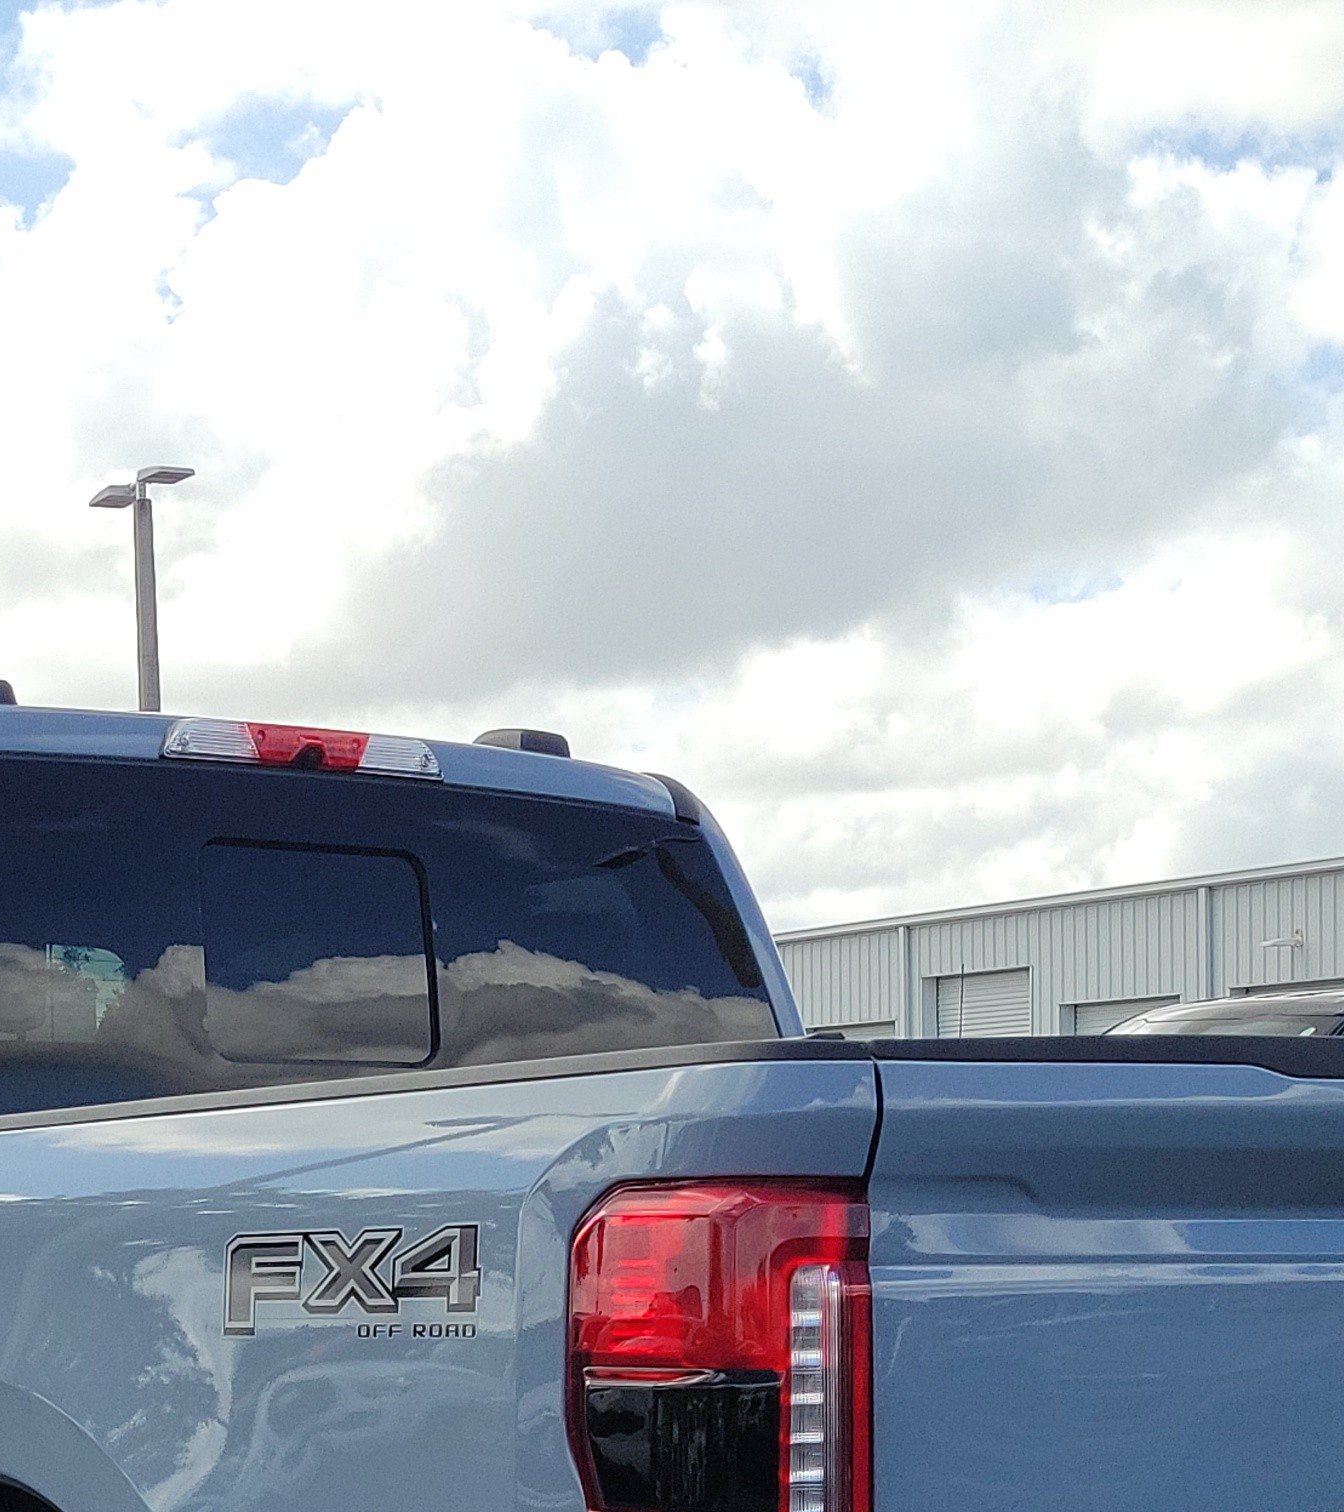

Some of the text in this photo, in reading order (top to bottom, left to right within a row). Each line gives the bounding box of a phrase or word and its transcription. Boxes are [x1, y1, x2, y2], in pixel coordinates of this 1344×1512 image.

[223, 1223, 481, 1337] FX4
[357, 1323, 477, 1338] OFF ROAD
